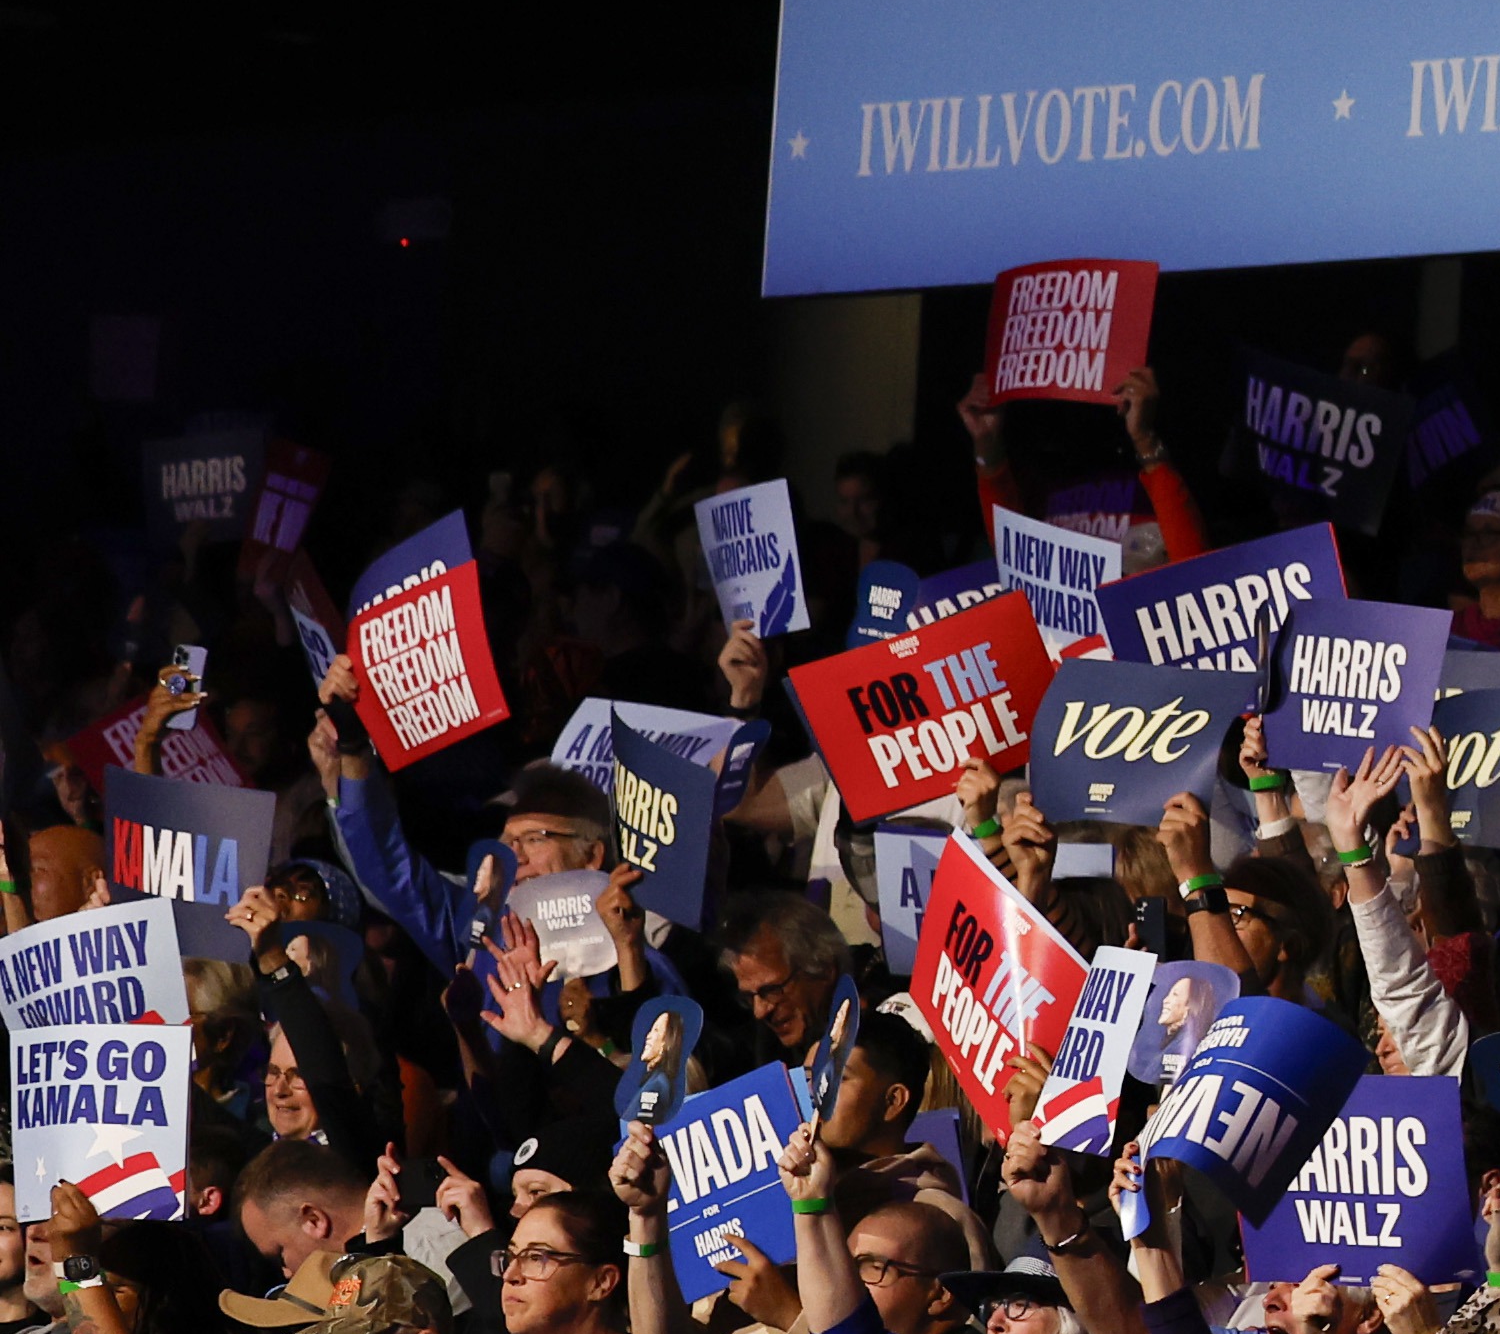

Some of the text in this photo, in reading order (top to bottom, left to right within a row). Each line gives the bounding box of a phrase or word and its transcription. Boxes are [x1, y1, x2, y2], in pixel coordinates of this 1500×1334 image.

[858, 73, 1266, 177] IWILLVOTE.COM
[1009, 270, 1117, 313] FREEDOM
[1002, 311, 1110, 352] FREEDOM
[997, 352, 1105, 395] FREEDOM
[1246, 374, 1383, 469] HARRIS
[162, 455, 246, 497] HARRIS
[1257, 440, 1338, 499] WALZ
[711, 497, 755, 538] NATIVE
[1014, 534, 1105, 592] NEW WAY
[359, 585, 456, 667] FREEDOM
[366, 630, 468, 708] FREEDOM
[847, 642, 1008, 733] FOR THE
[1290, 635, 1407, 704] HARRIS
[386, 675, 480, 751] FREEDOM
[867, 691, 1027, 788] PEOPLE
[1053, 696, 1210, 764] vote
[1302, 699, 1376, 739] WALZ
[113, 816, 239, 905] KAMALA
[537, 893, 592, 918] HARRIS
[547, 915, 585, 931] WALZ
[13, 921, 148, 999] NEW WAY
[944, 900, 993, 989] FOR
[931, 951, 1014, 1096] PEOPLE
[1077, 968, 1135, 1025] WAY
[17, 1040, 166, 1085] LET'S GO
[17, 1086, 168, 1130] KAMALA
[694, 1218, 745, 1258] HARRIS
[1295, 1199, 1402, 1249] WALZ
